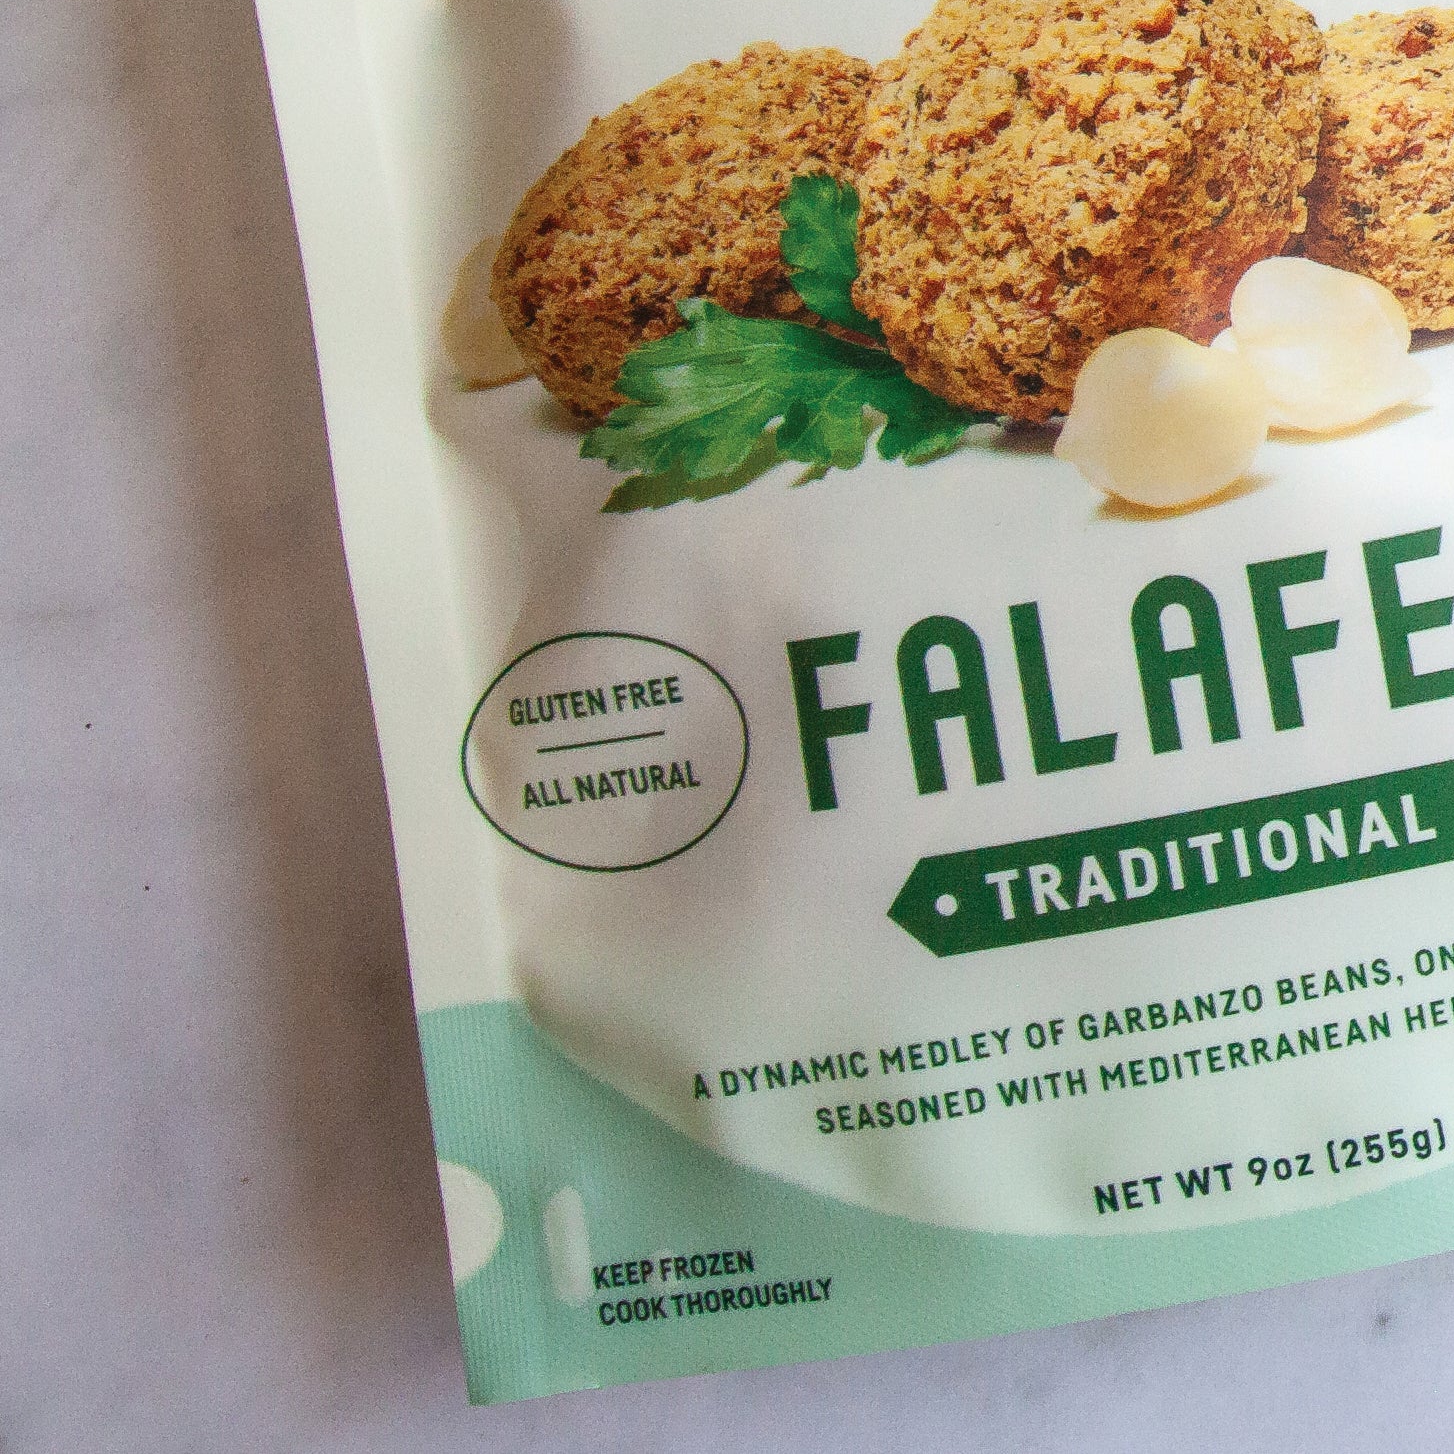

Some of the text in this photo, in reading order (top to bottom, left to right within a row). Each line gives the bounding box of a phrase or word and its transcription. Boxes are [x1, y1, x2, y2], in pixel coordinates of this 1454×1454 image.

[508, 676, 684, 727] GLUTEN FREE
[522, 760, 701, 810] ALL NATURAL
[985, 794, 1438, 922] TRADITIONAL
[692, 1073, 712, 1101] A
[720, 1051, 869, 1099] DYNAMIC
[879, 1027, 1012, 1076] MEDLEY
[1023, 1018, 1066, 1051] OF
[1078, 983, 1264, 1043] GARBANZO
[1277, 957, 1405, 1007] BEANS,
[815, 1087, 987, 1136] SEASONED
[996, 1066, 1088, 1108] WITH
[1099, 1011, 1393, 1093] MEDITERRANEAN
[1092, 1174, 1164, 1215] NET
[1175, 1162, 1234, 1200] WT
[1247, 1152, 1315, 1187] 9oz
[592, 1249, 756, 1290] KEEP FROZEN
[598, 1276, 833, 1326] COOK THOROUGHLY
